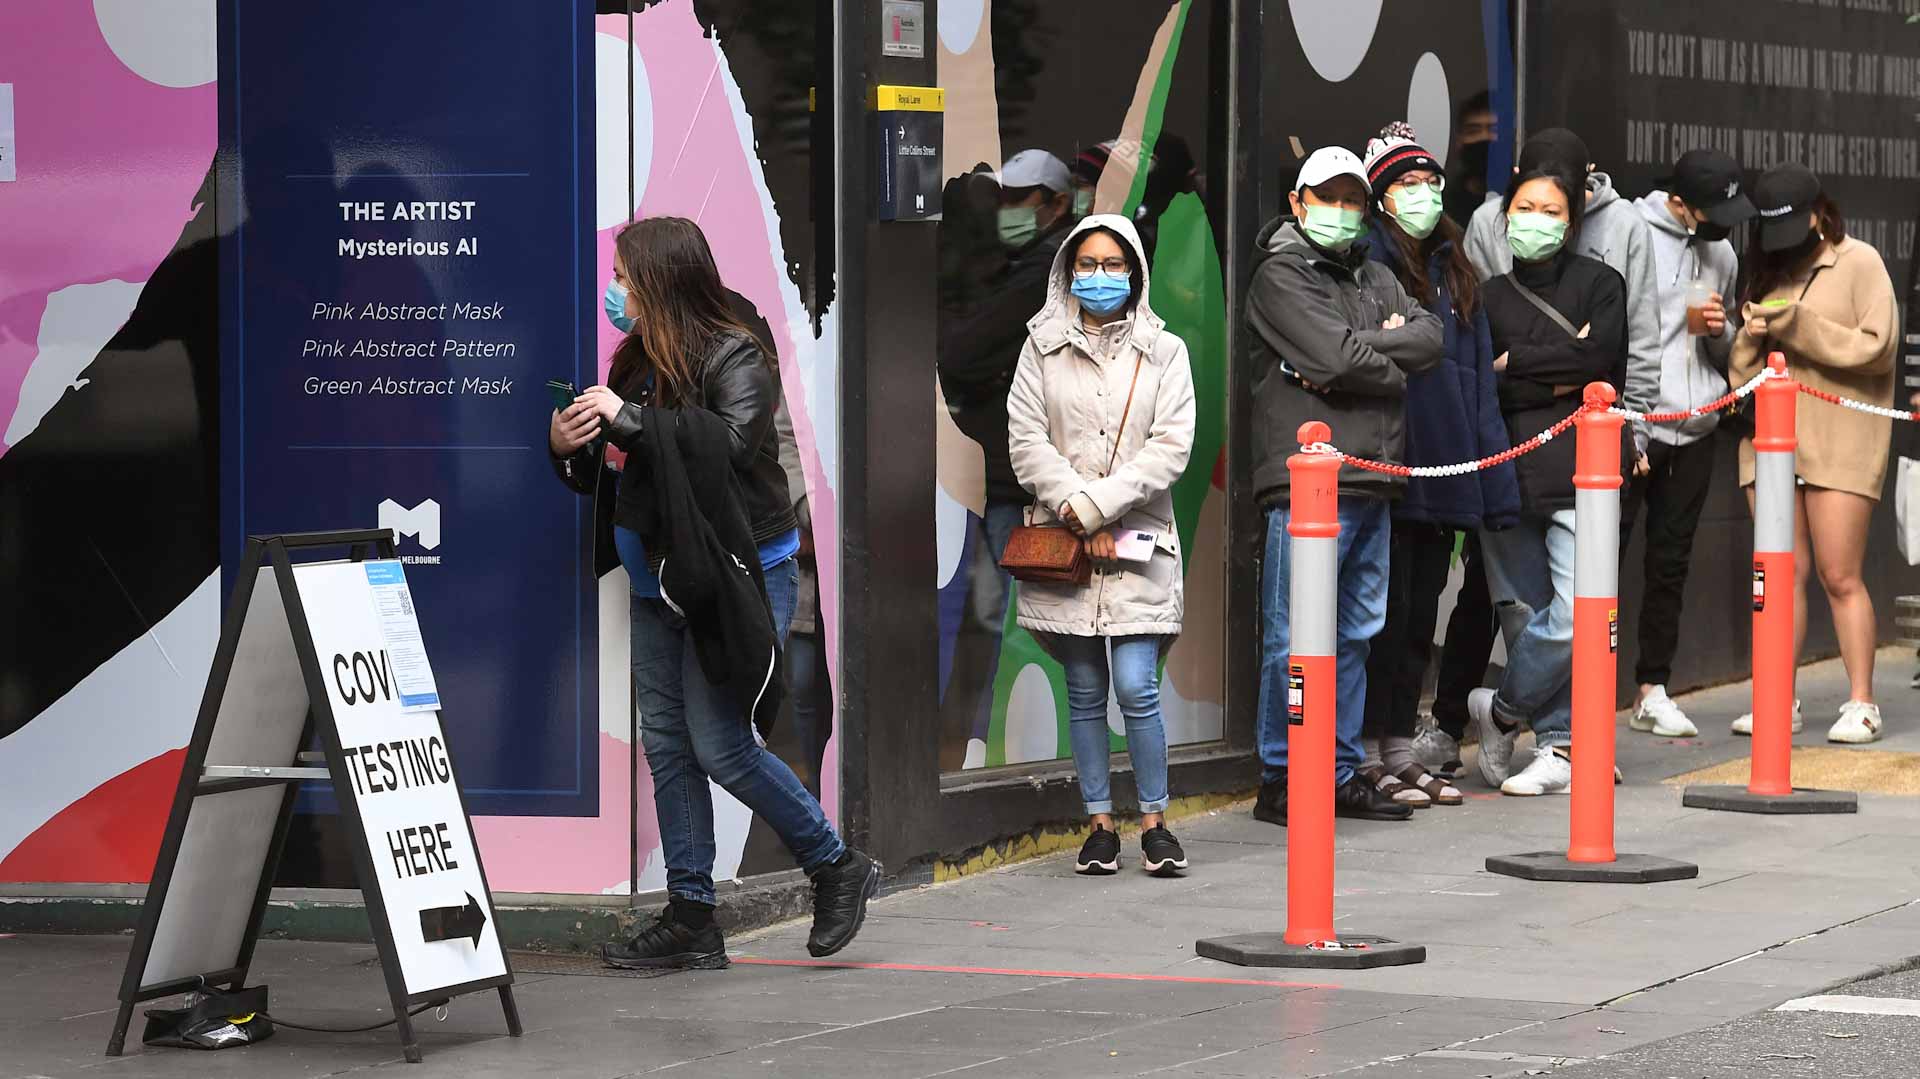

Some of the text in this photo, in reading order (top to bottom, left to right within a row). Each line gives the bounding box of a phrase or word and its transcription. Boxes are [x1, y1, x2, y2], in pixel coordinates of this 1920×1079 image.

[1628, 30, 1654, 75] YOU
[1658, 32, 1696, 79] CAN'T
[1701, 37, 1726, 82] WIN
[1730, 40, 1747, 84] AS
[1752, 42, 1760, 85] A
[1763, 43, 1808, 88] WOMAN
[1813, 48, 1827, 89] IN
[1832, 51, 1853, 93] THE
[1856, 52, 1878, 94] ART
[1627, 120, 1666, 164] DON'T
[1743, 128, 1777, 171] WHEN
[1783, 132, 1804, 162] THE
[1809, 132, 1844, 175] GOING
[1848, 136, 1876, 176] GETS
[339, 201, 476, 220] THE ARTIST
[338, 238, 449, 259] Mysterious
[312, 301, 504, 320] Pink Abstract Mask
[302, 339, 516, 357] Pink Abstract Pattern
[303, 376, 513, 395] Green Abstract Mask
[402, 556, 441, 565] MELBOURNE
[333, 648, 399, 706] COV
[345, 736, 450, 795] TESTING
[386, 822, 459, 879] HERE
